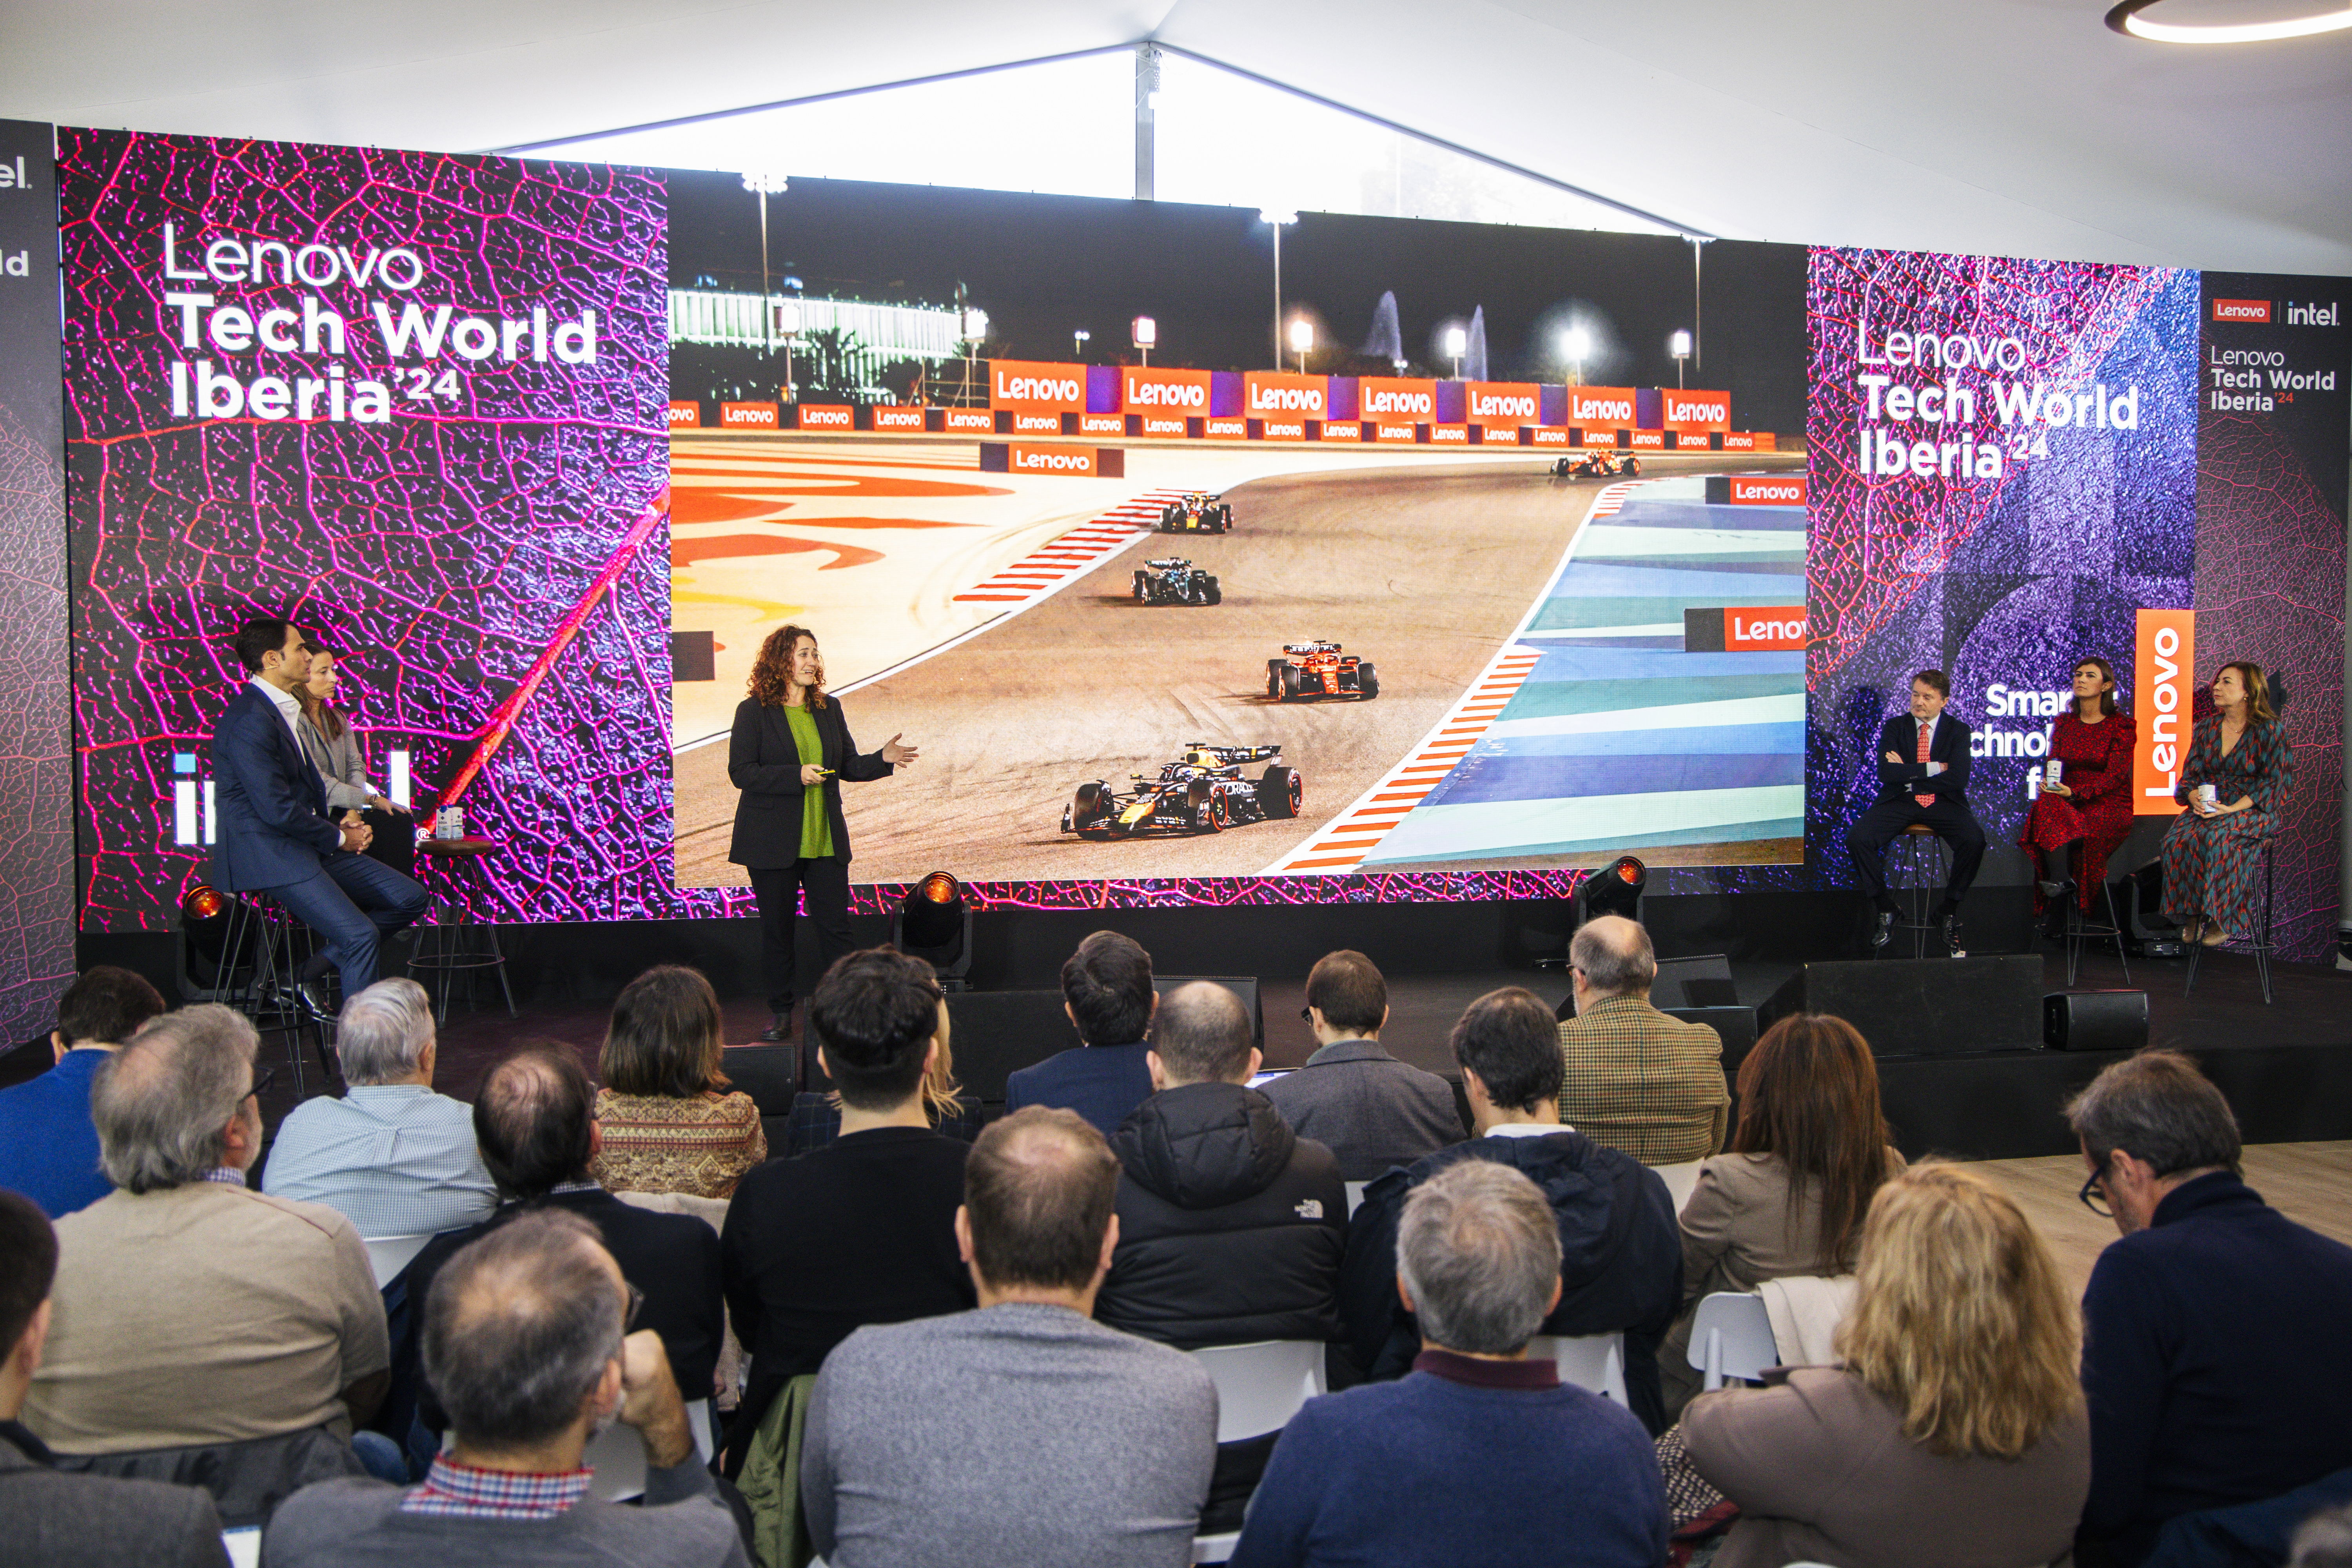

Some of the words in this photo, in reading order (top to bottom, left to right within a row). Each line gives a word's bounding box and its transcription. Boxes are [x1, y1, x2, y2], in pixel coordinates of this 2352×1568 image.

[165, 223, 423, 290] Lenovo
[2218, 304, 2265, 317] Lenovo
[2288, 301, 2337, 326] intel
[166, 293, 345, 354] Tech
[372, 302, 597, 363] World
[1858, 320, 2026, 371] Lenovo
[2212, 346, 2285, 366] Lenovo
[998, 371, 1079, 401] Lenovo
[2211, 368, 2261, 388] Tech
[2269, 370, 2335, 390] World
[172, 361, 391, 423] Iberia
[1129, 377, 1205, 407] Lenovo
[1251, 383, 1322, 411] Lenovo
[1365, 387, 1431, 414] Lenovo
[2212, 391, 2273, 411] Iberia
[1472, 390, 1535, 417] Lenovo
[1573, 395, 1632, 420] Lenovo
[1668, 398, 1726, 423] Lenovo
[1858, 375, 1973, 423] Tech
[1992, 381, 2138, 430] World
[670, 408, 694, 421] ovo
[725, 407, 773, 423] Lenovo
[803, 408, 849, 425] Lenovo
[877, 411, 921, 426] Lenovo
[947, 412, 991, 428] Lenovo
[1016, 414, 1058, 430] Lenovo
[1082, 417, 1122, 432] Lenovo
[1145, 418, 1183, 433] Lenovo
[1206, 420, 1244, 435] Lenovo
[1265, 422, 1302, 436] Lenovo
[1323, 423, 1358, 437] Lenovo
[1379, 425, 1413, 439] Lenovo
[1432, 426, 1465, 440] Lenovo
[1485, 428, 1516, 441] Lenovo
[1534, 429, 1566, 443] Lenovo
[1584, 431, 1614, 443] Lenovo
[1632, 433, 1661, 445] Lenovo
[1679, 434, 1707, 446] Lenovo
[1724, 435, 1752, 447] Lenovo
[1016, 450, 1090, 470] Lenovo
[1860, 429, 2002, 478] Iberia
[1736, 483, 1800, 500] Lenovo
[1986, 684, 2118, 717] Smar
[2145, 627, 2179, 797] Lenovo
